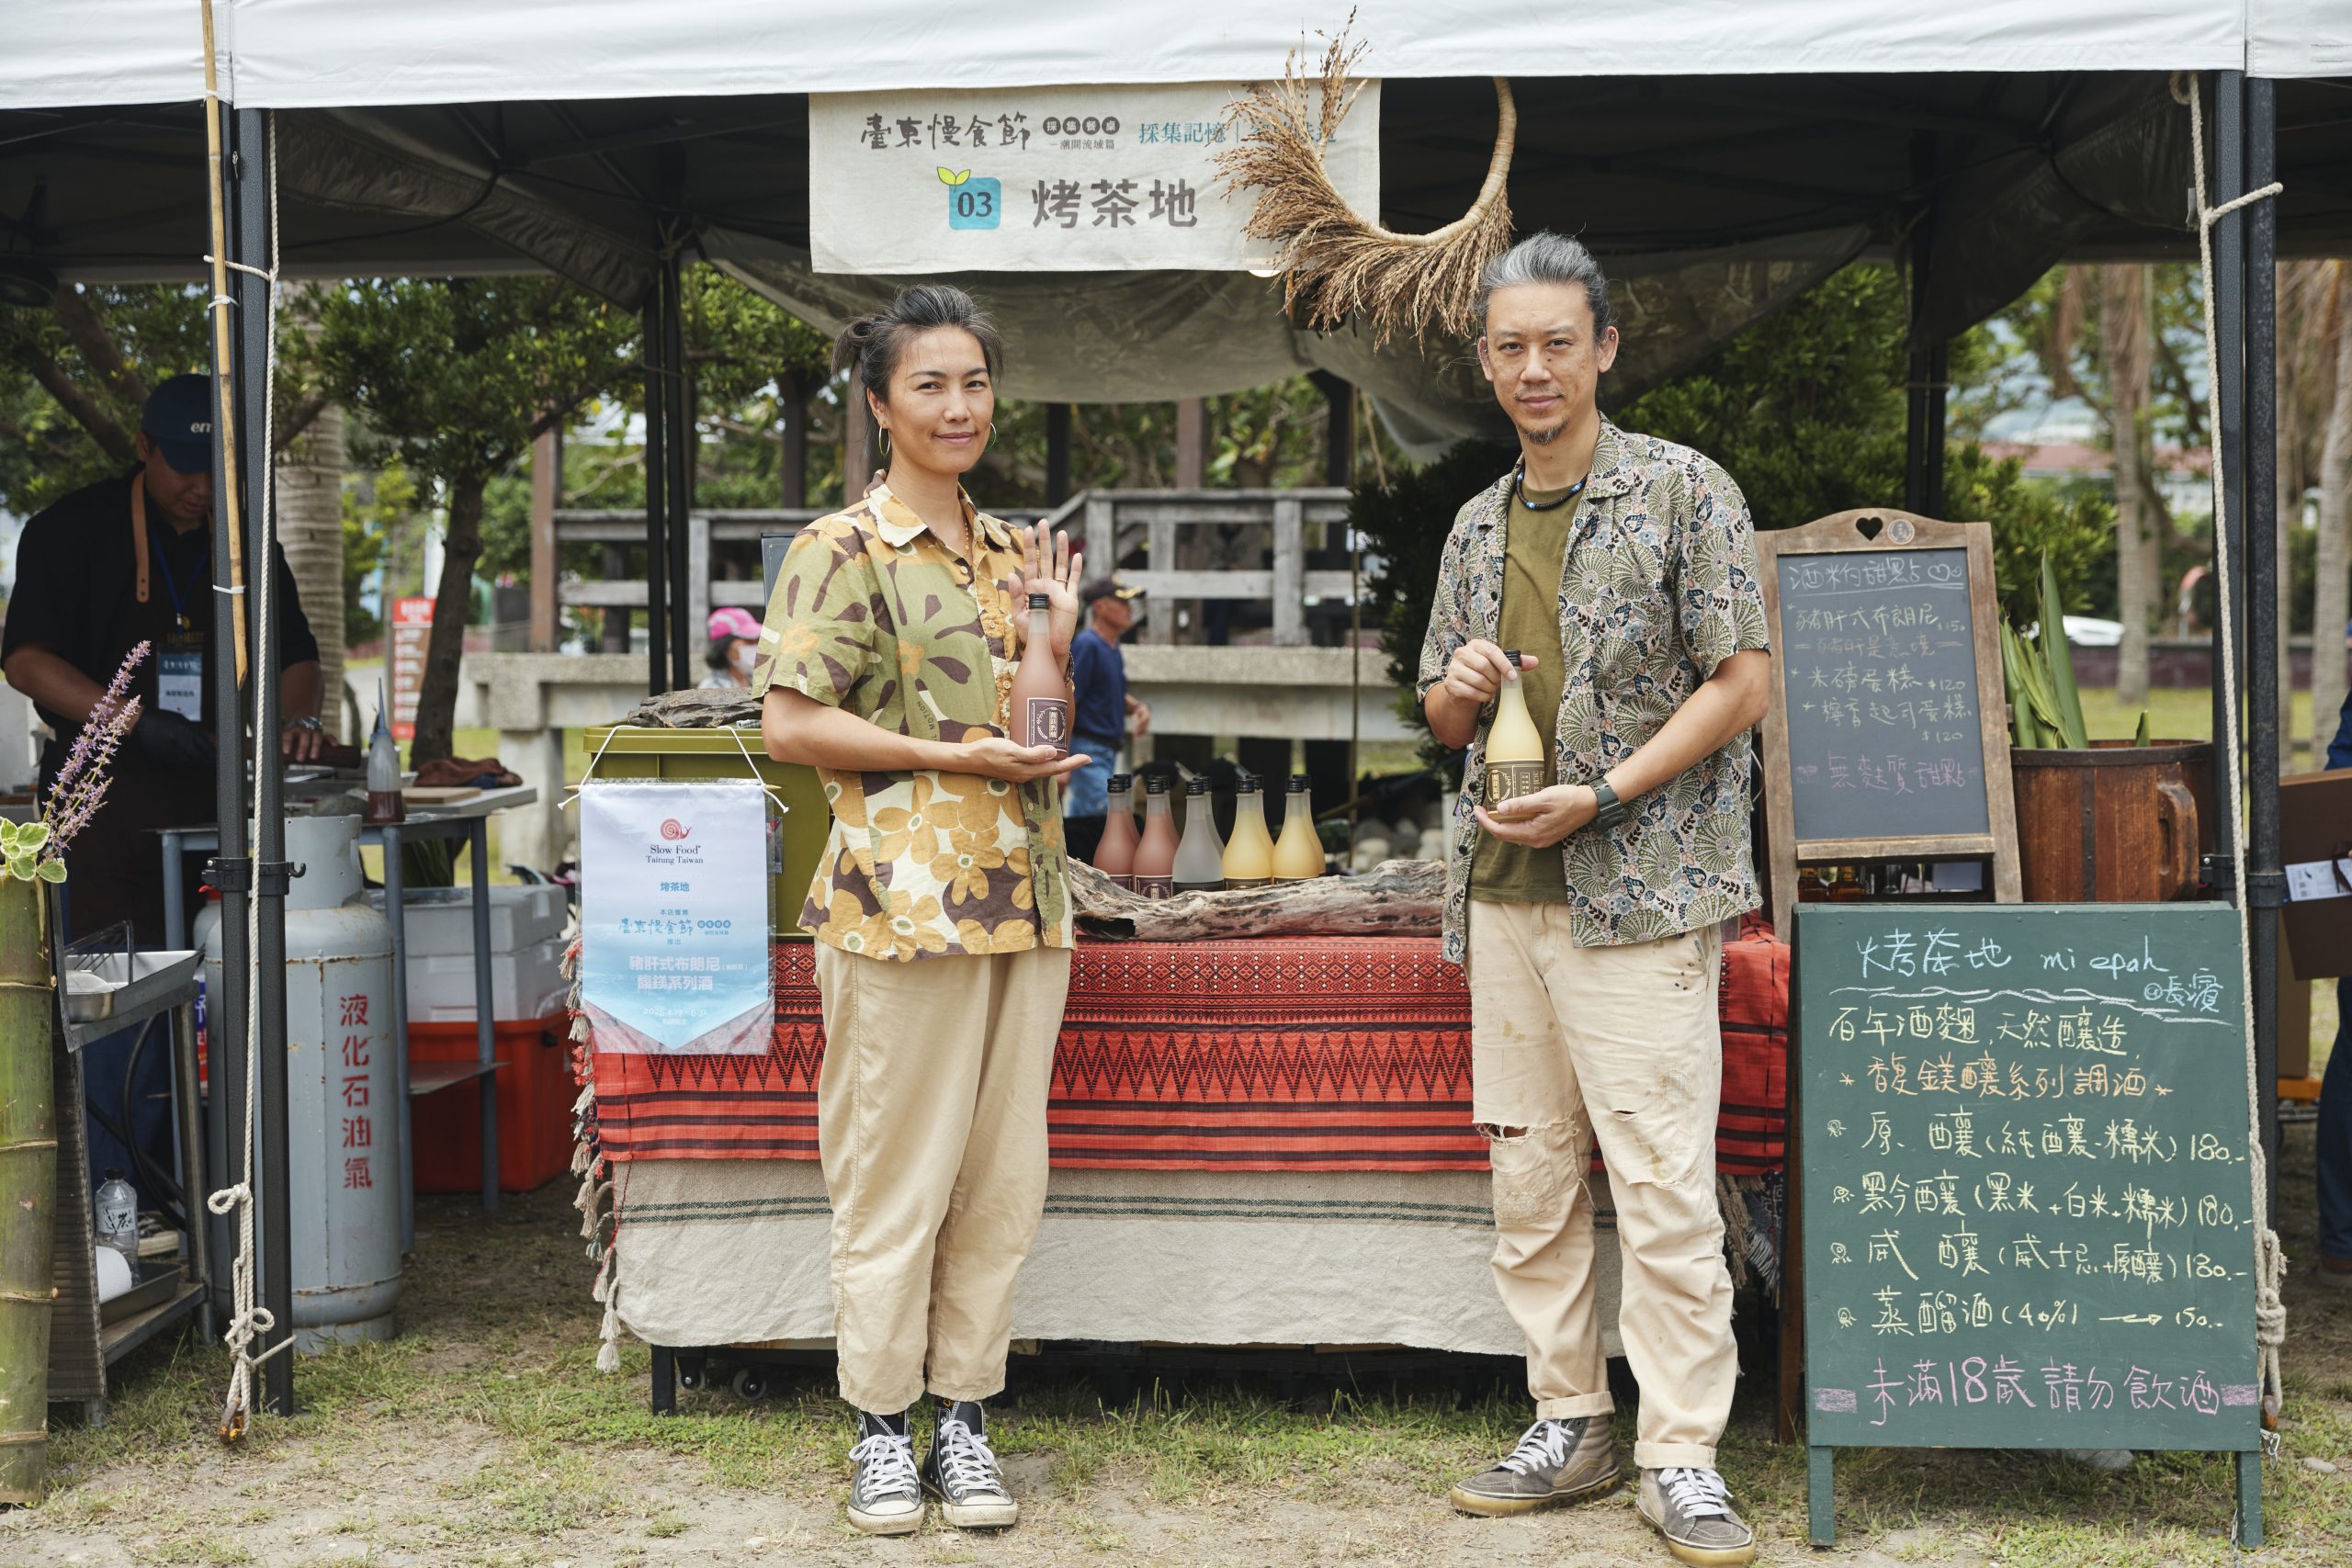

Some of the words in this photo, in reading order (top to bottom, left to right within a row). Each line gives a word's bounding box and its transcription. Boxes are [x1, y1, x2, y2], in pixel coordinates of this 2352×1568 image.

[861, 111, 1031, 151] 臺東慢食節
[956, 191, 993, 218] 03
[1031, 178, 1198, 229] 烤茶地
[1927, 678, 1966, 691] $120
[1920, 729, 1963, 743] $120
[650, 844, 673, 854] Slow
[645, 855, 675, 865] Taitung
[676, 855, 704, 864] Taiwan
[660, 881, 690, 893] 烤茶地
[1856, 927, 2012, 978] 烤茶地
[628, 954, 721, 972] 豬肝式布朗尼
[339, 994, 373, 1190] 液化石油氣
